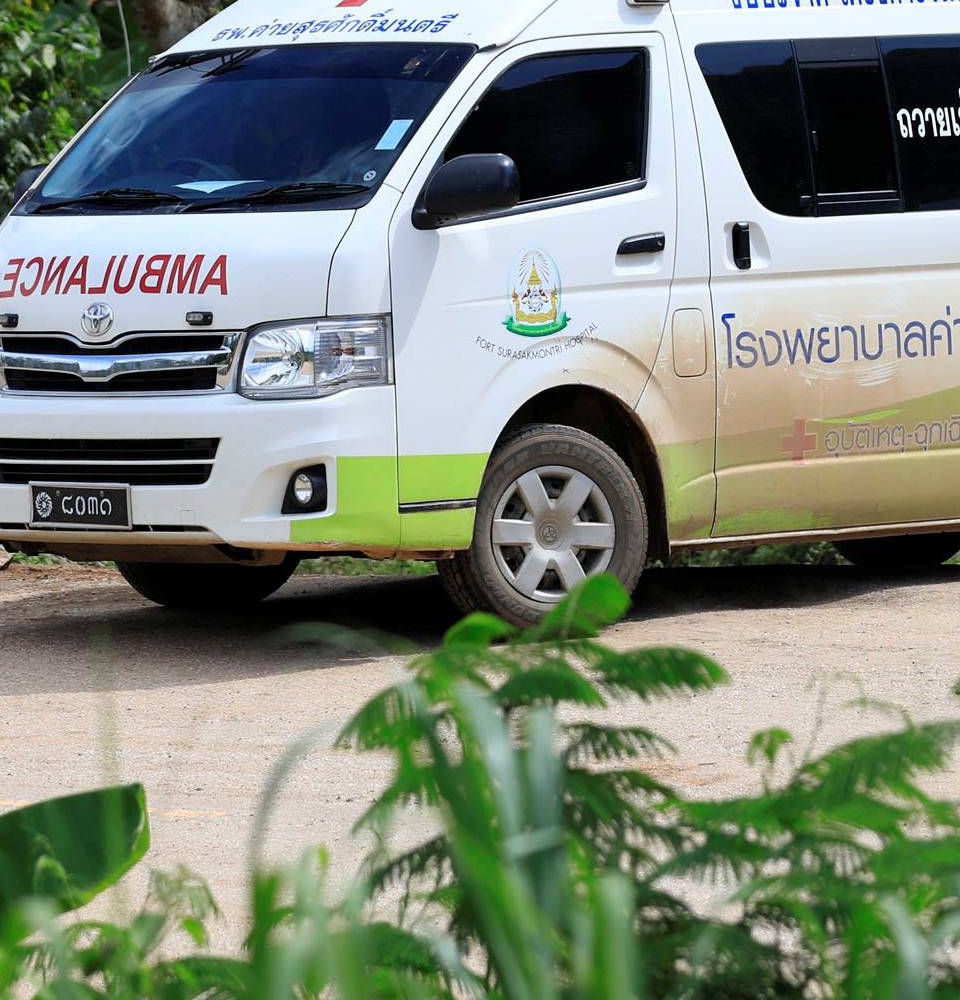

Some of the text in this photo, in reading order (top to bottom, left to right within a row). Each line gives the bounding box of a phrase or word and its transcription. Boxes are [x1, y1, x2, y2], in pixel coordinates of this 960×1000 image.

[476, 336, 496, 353] FORT
[497, 346, 563, 360] SURASAKMONTRI
[565, 322, 599, 350] HOSPITAL
